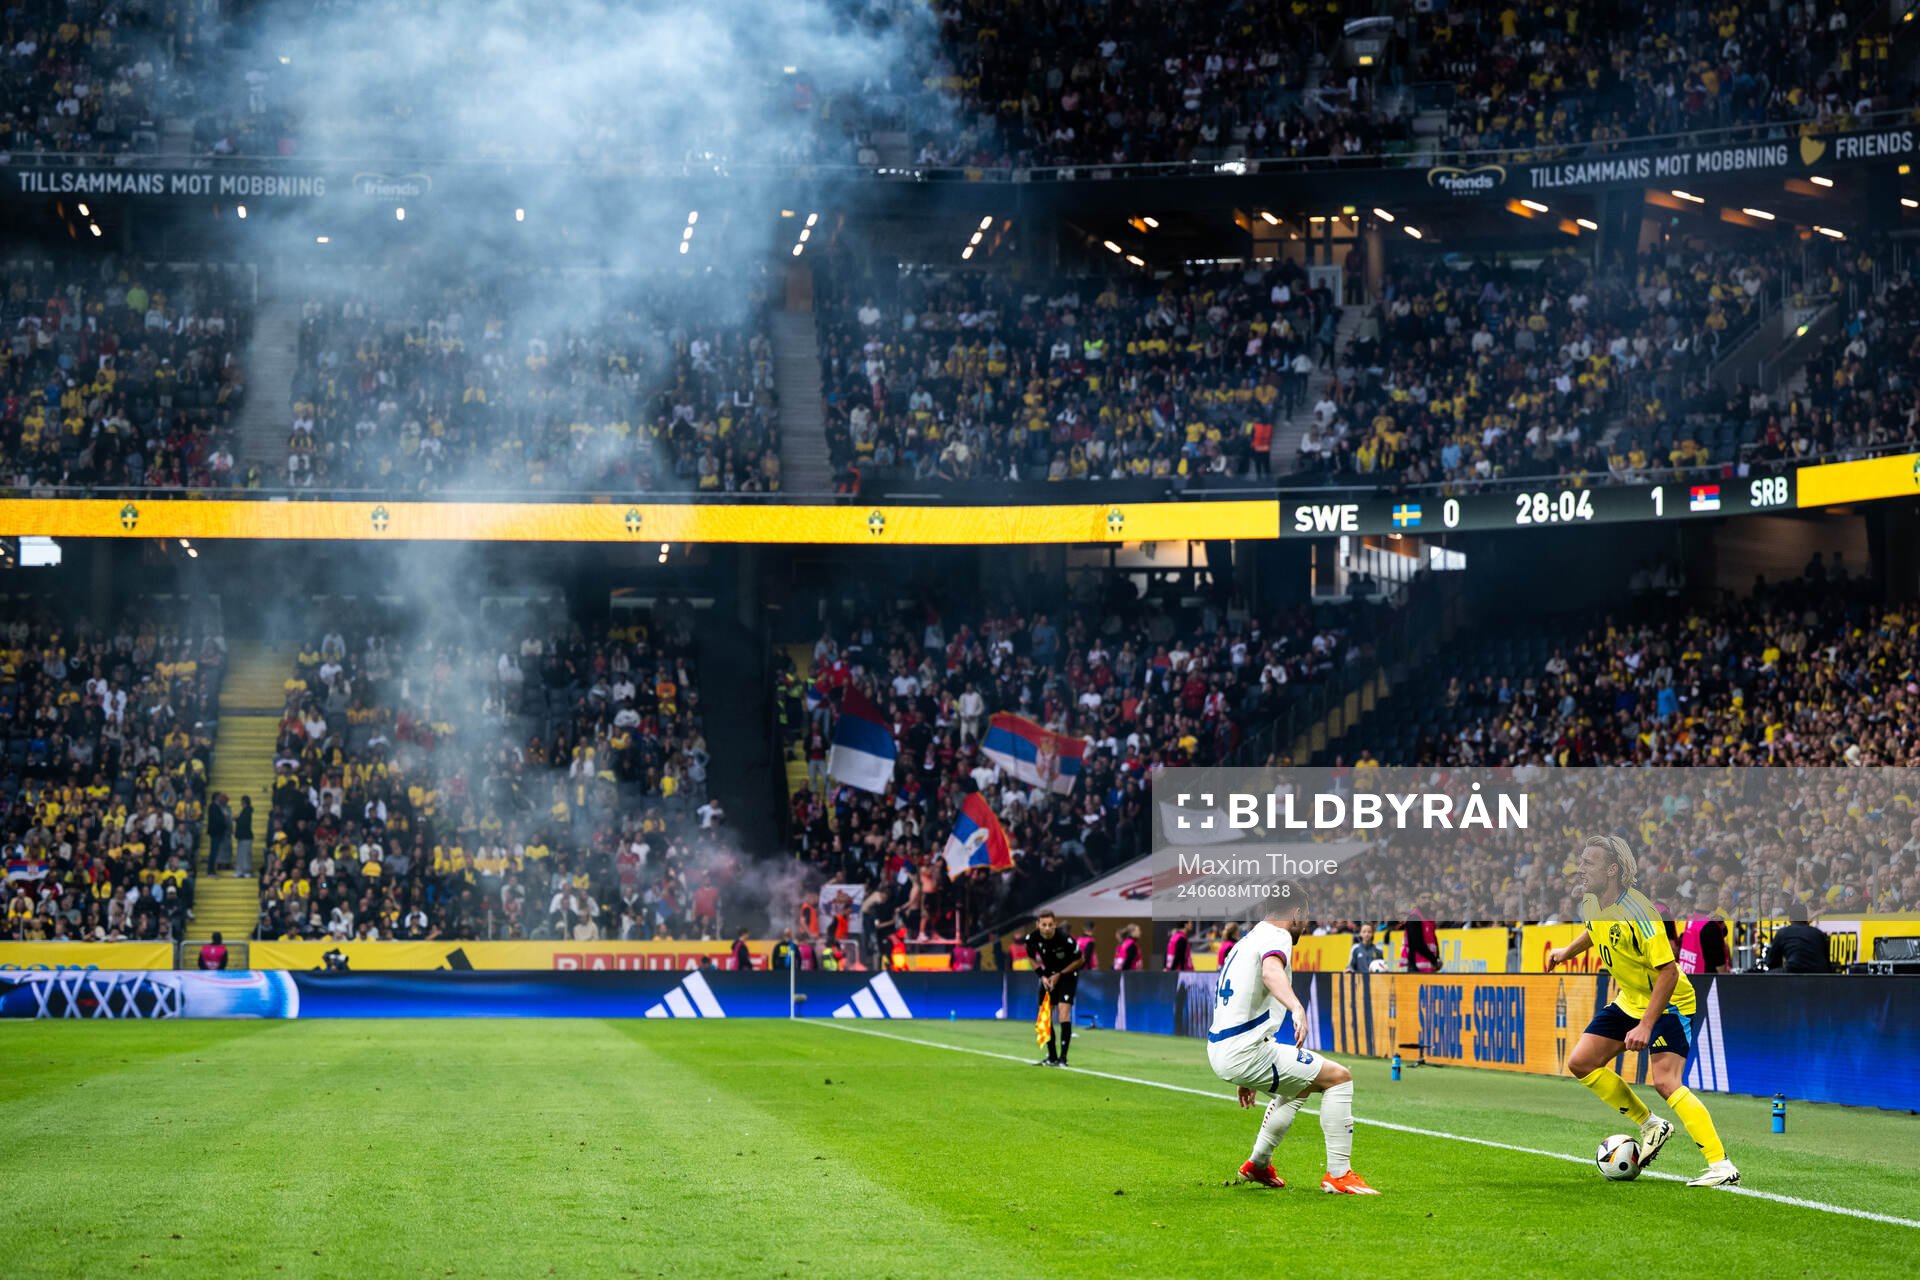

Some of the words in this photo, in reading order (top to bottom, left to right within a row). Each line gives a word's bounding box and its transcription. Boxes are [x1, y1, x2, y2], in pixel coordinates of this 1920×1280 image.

[1530, 157, 1650, 188] TILLSAMMANS
[1656, 154, 1690, 177] MOT
[1697, 145, 1789, 172] MOBBNING
[1835, 131, 1913, 160] FRIENDS
[18, 172, 165, 194] TILLSAMMANS
[171, 174, 213, 195] MOT
[219, 175, 326, 196] MOBBNING
[1295, 504, 1359, 533] SWE
[1443, 499, 1460, 528] 0
[1516, 489, 1595, 525] 28:04
[1651, 486, 1664, 517] 1
[1750, 476, 1789, 508] SRB
[1418, 983, 1463, 1060] SVERIGE
[1473, 985, 1526, 1065] SERBIEN
